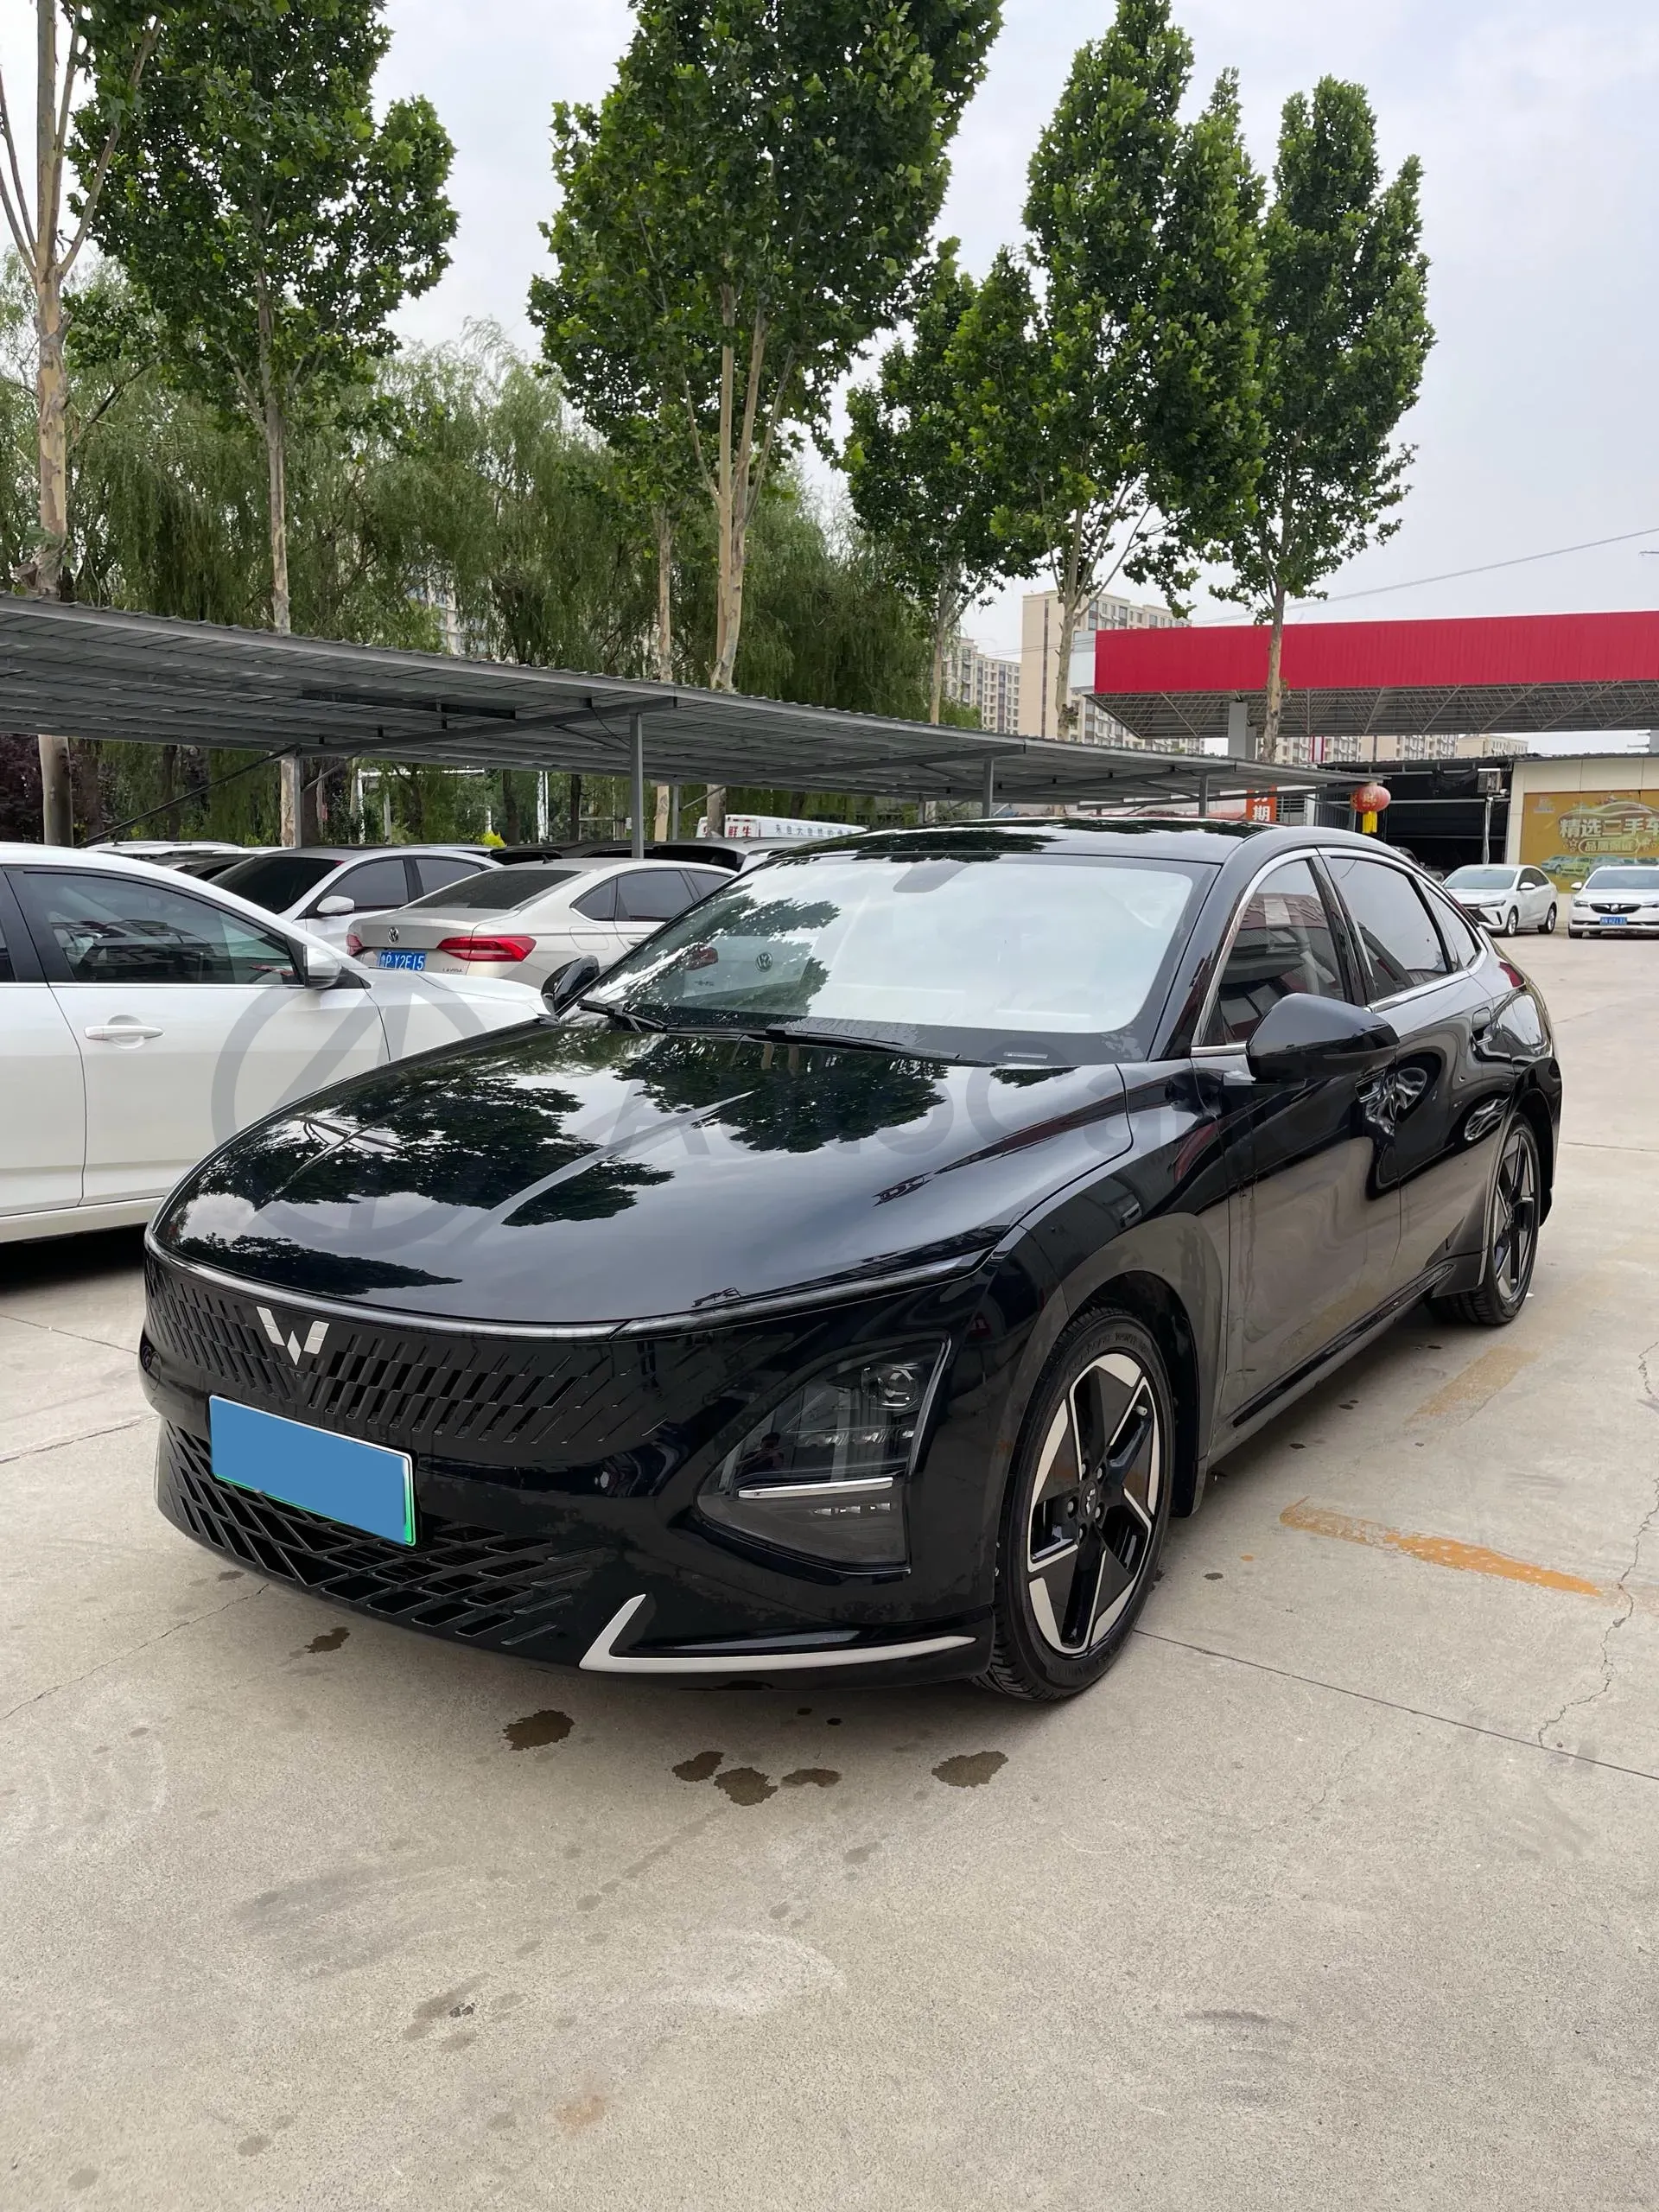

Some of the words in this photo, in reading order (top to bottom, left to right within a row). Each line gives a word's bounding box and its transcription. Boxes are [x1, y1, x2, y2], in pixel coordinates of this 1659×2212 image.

[1559, 816, 1659, 837] 精选二手车
